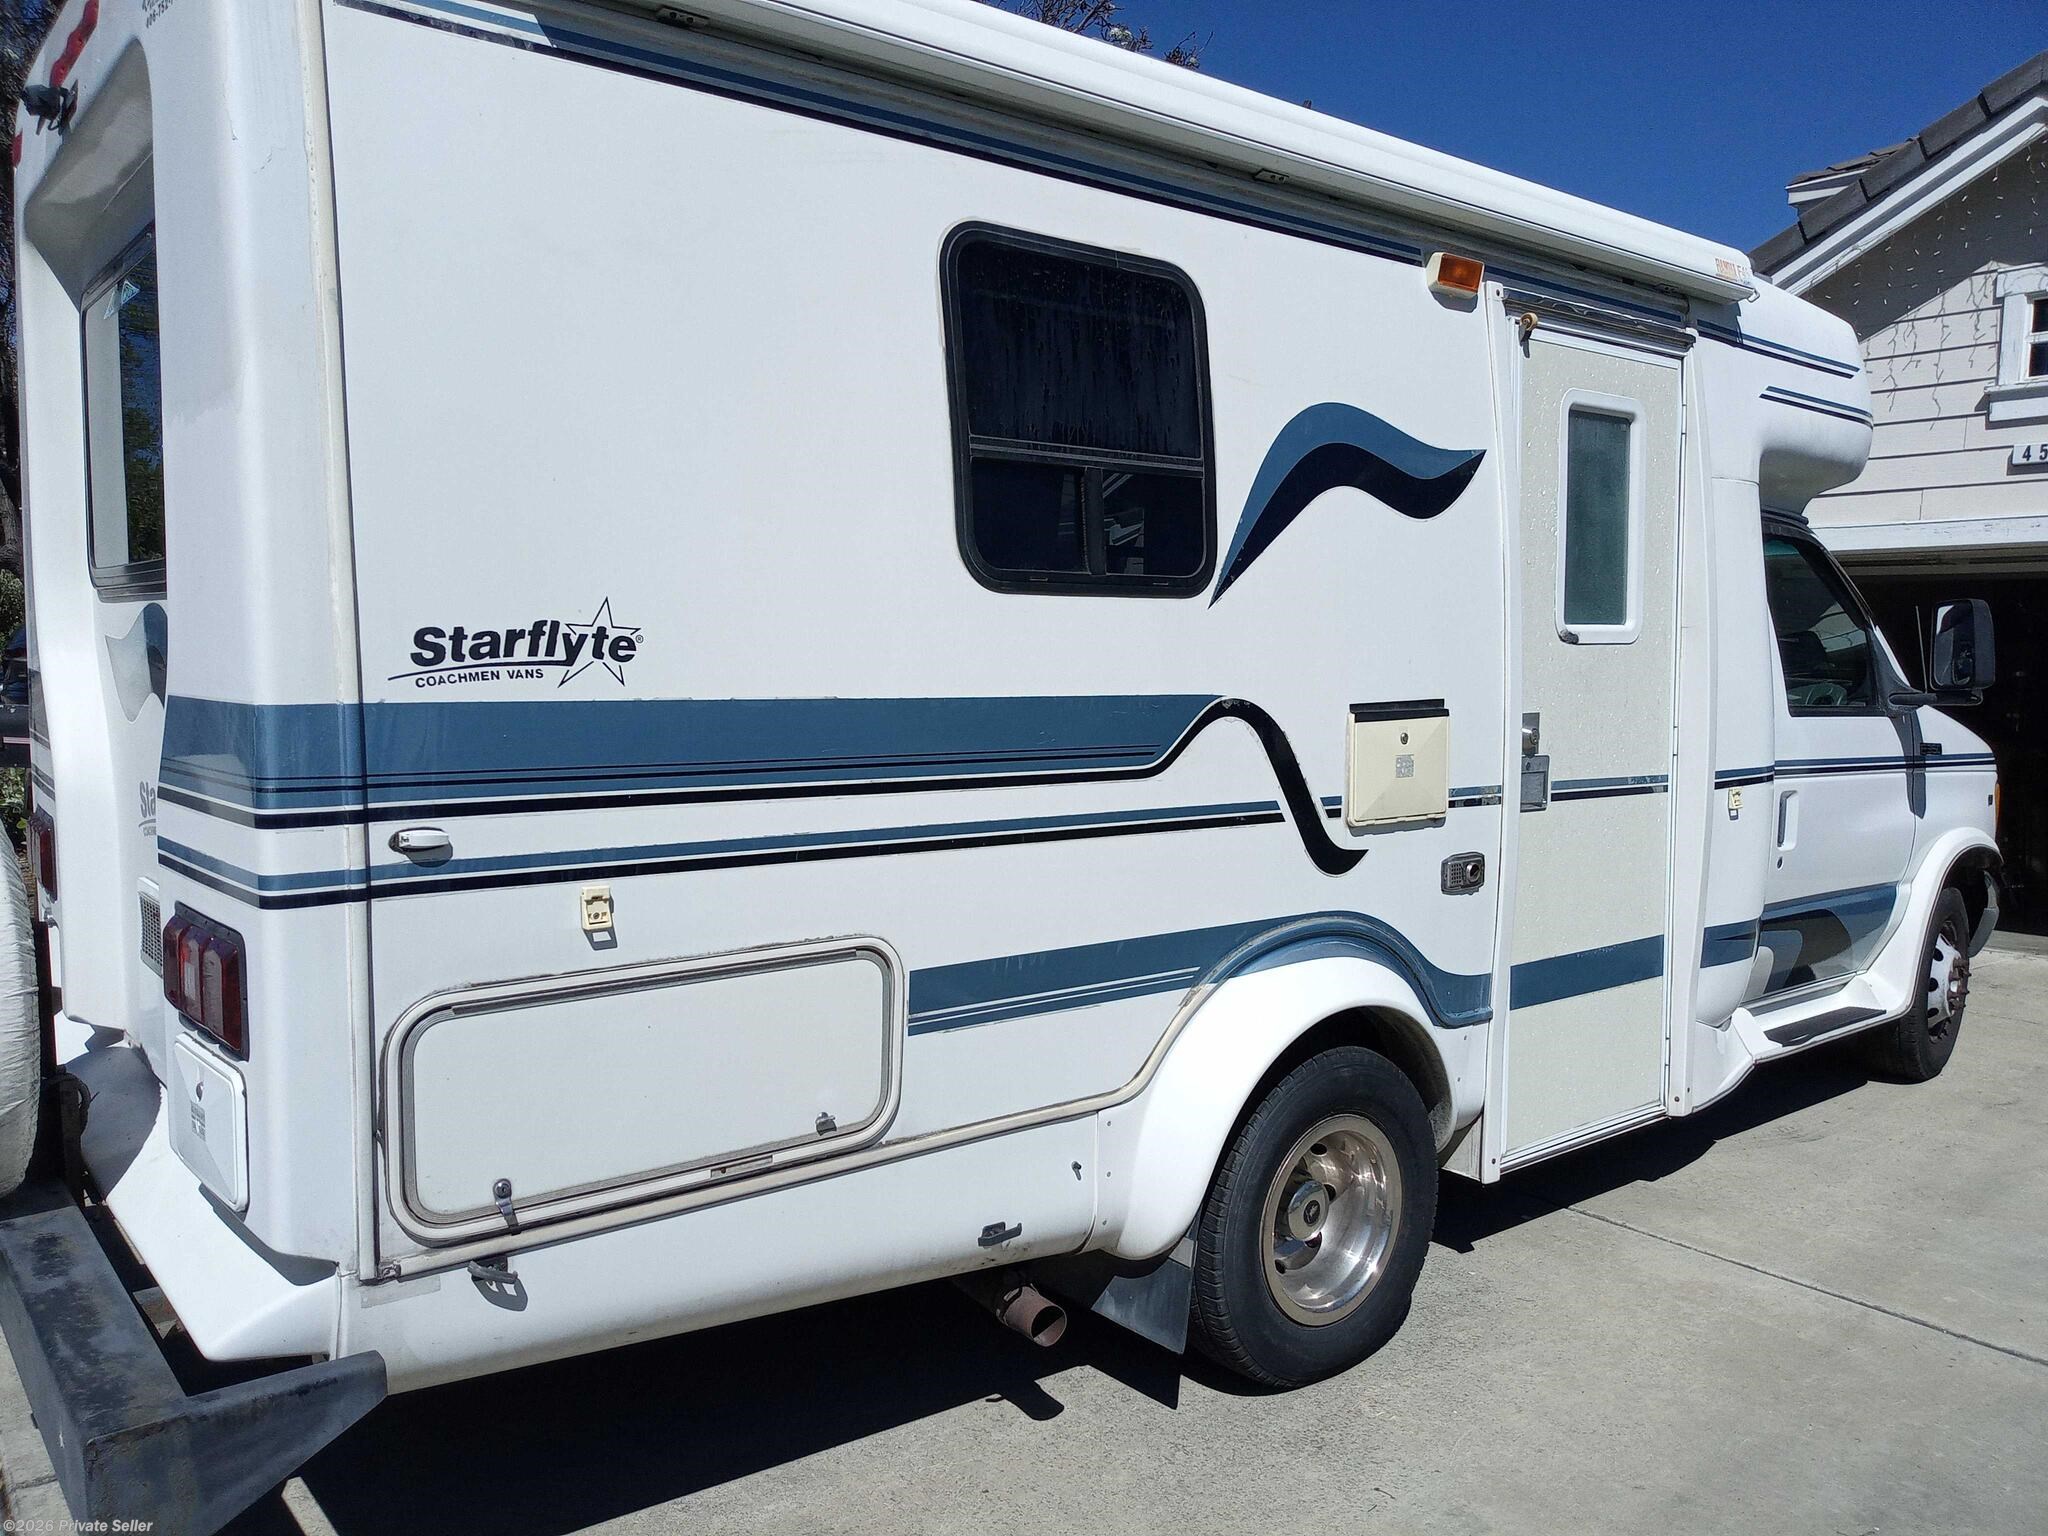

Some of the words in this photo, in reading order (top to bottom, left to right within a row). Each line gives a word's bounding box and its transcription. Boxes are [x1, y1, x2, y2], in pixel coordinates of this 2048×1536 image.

[415, 669, 500, 689] COACHMEN
[506, 668, 544, 681] VANS
[139, 781, 156, 818] Sta
